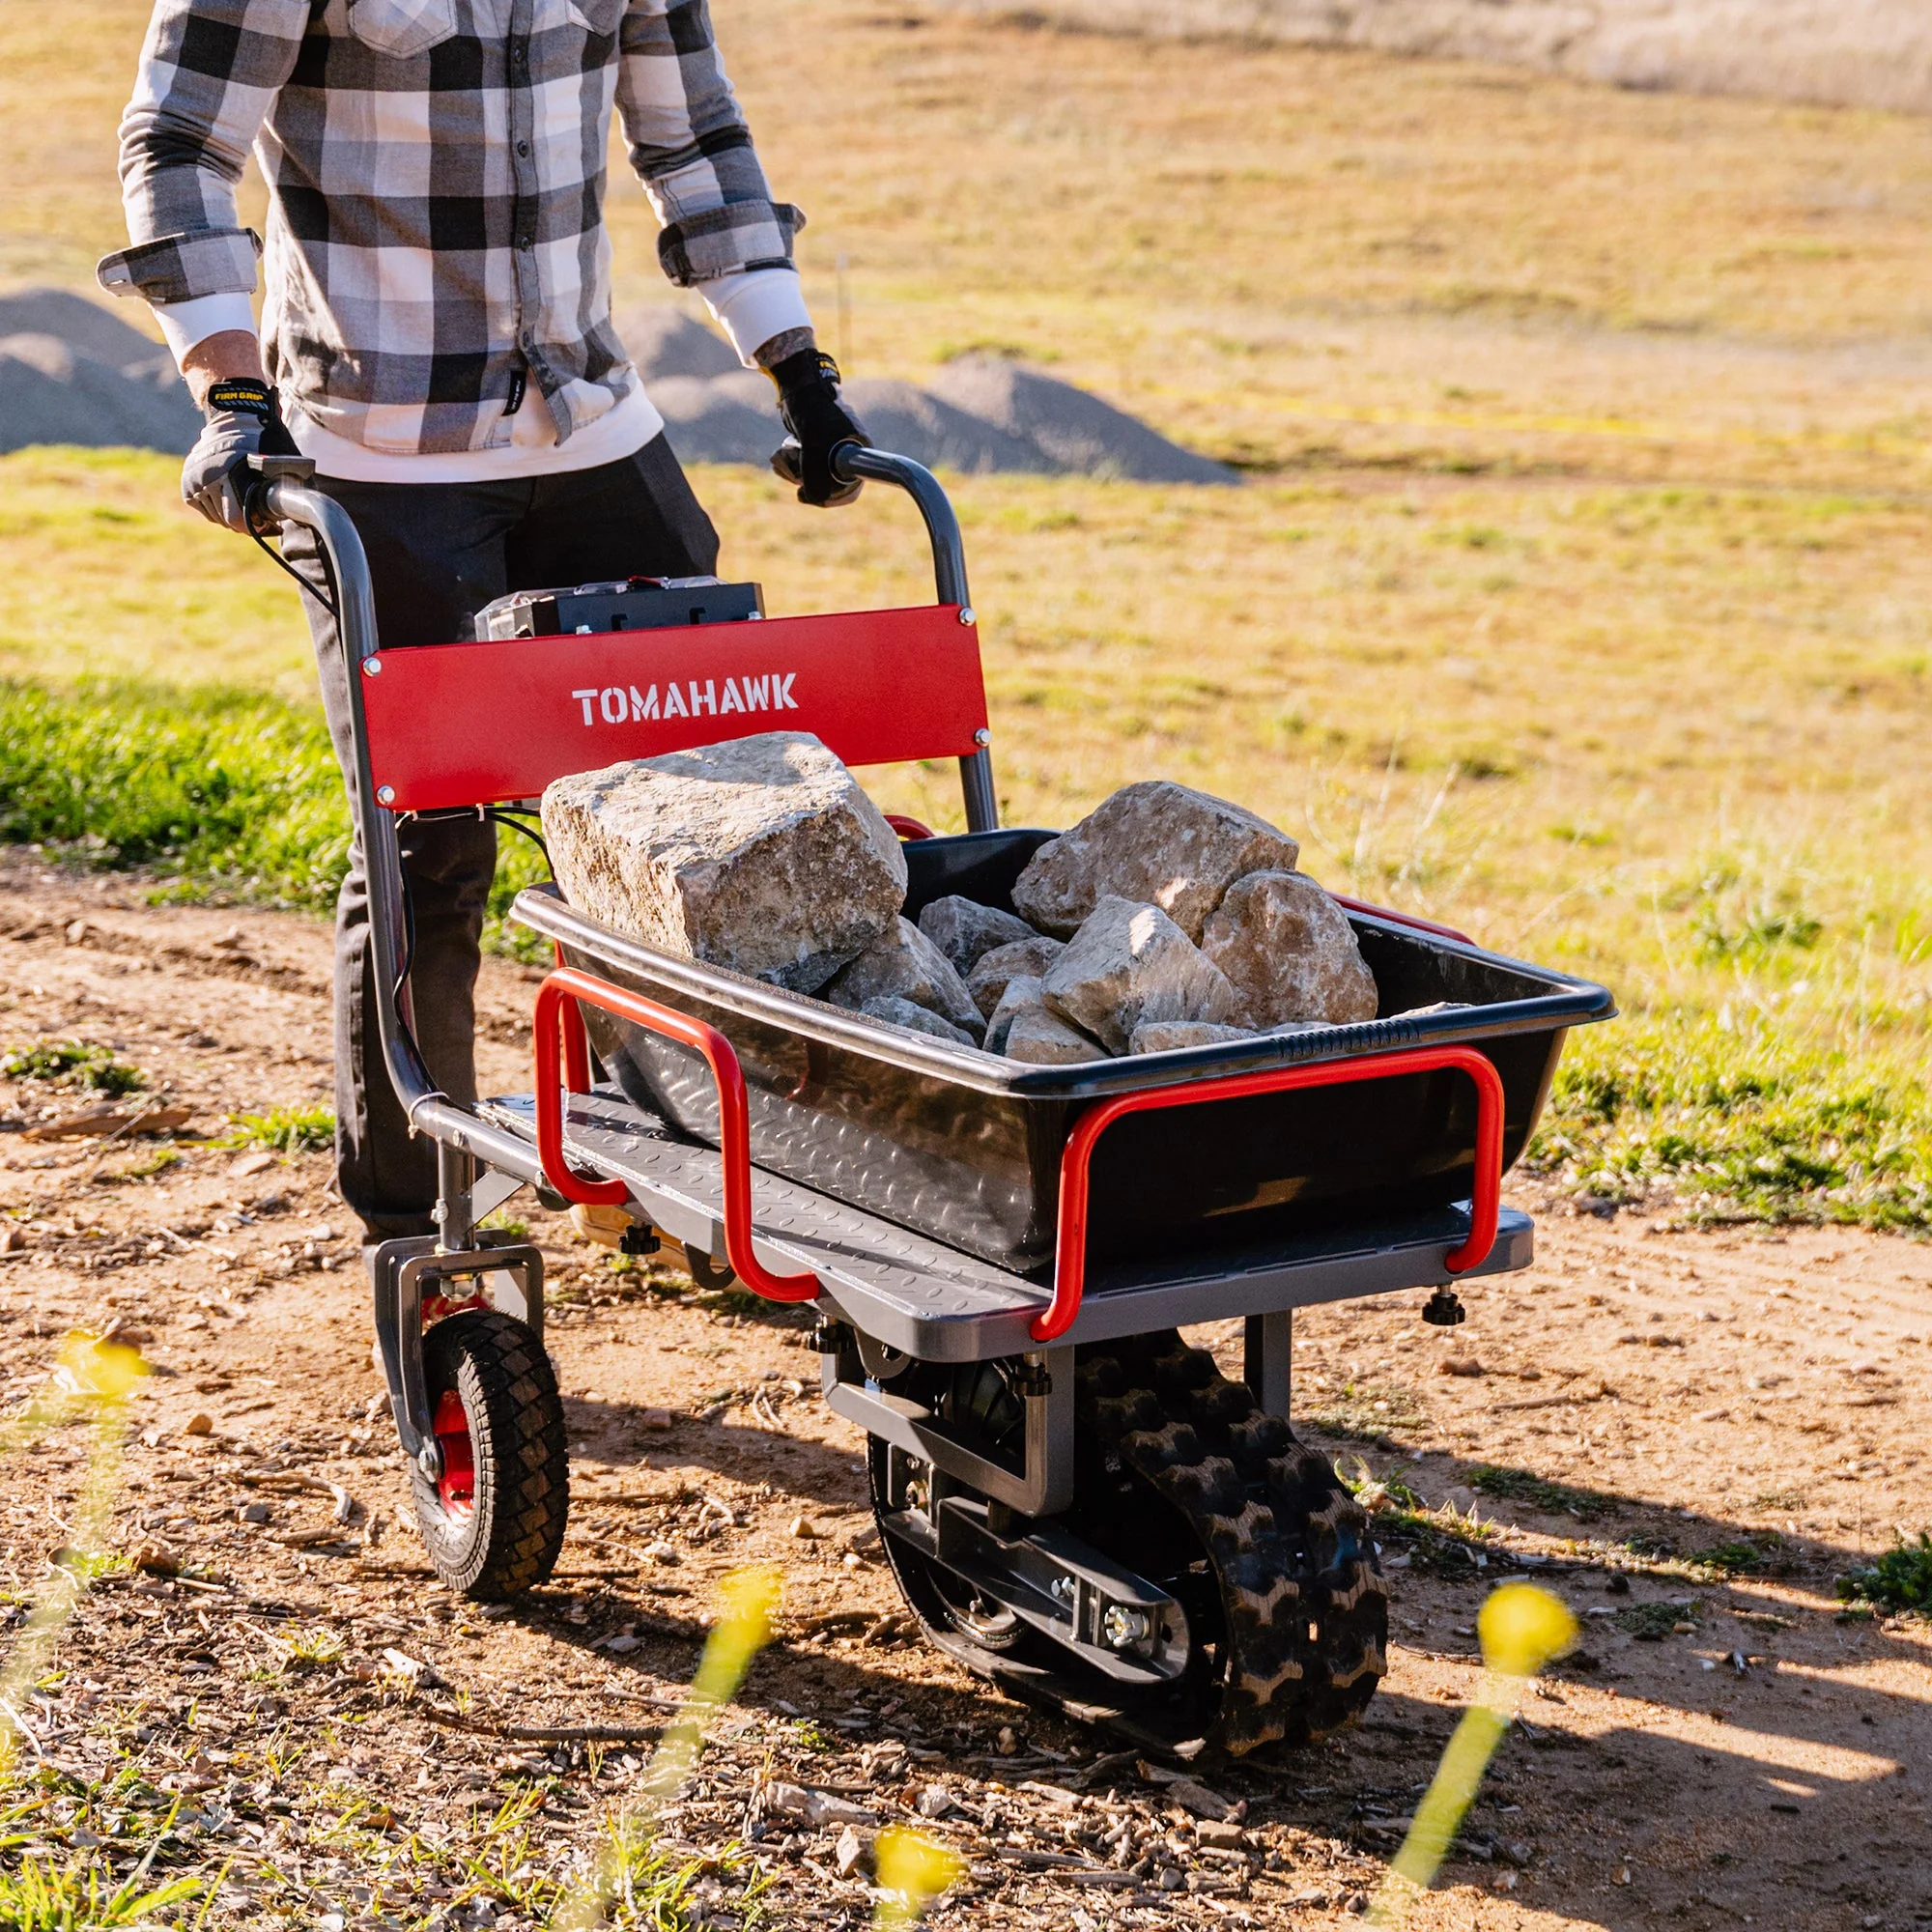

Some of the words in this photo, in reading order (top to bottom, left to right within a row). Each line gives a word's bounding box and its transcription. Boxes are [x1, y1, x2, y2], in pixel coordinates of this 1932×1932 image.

[214, 392, 238, 401] FIRM
[239, 391, 264, 401] GRIP
[572, 672, 799, 725] TOMAHAWK
